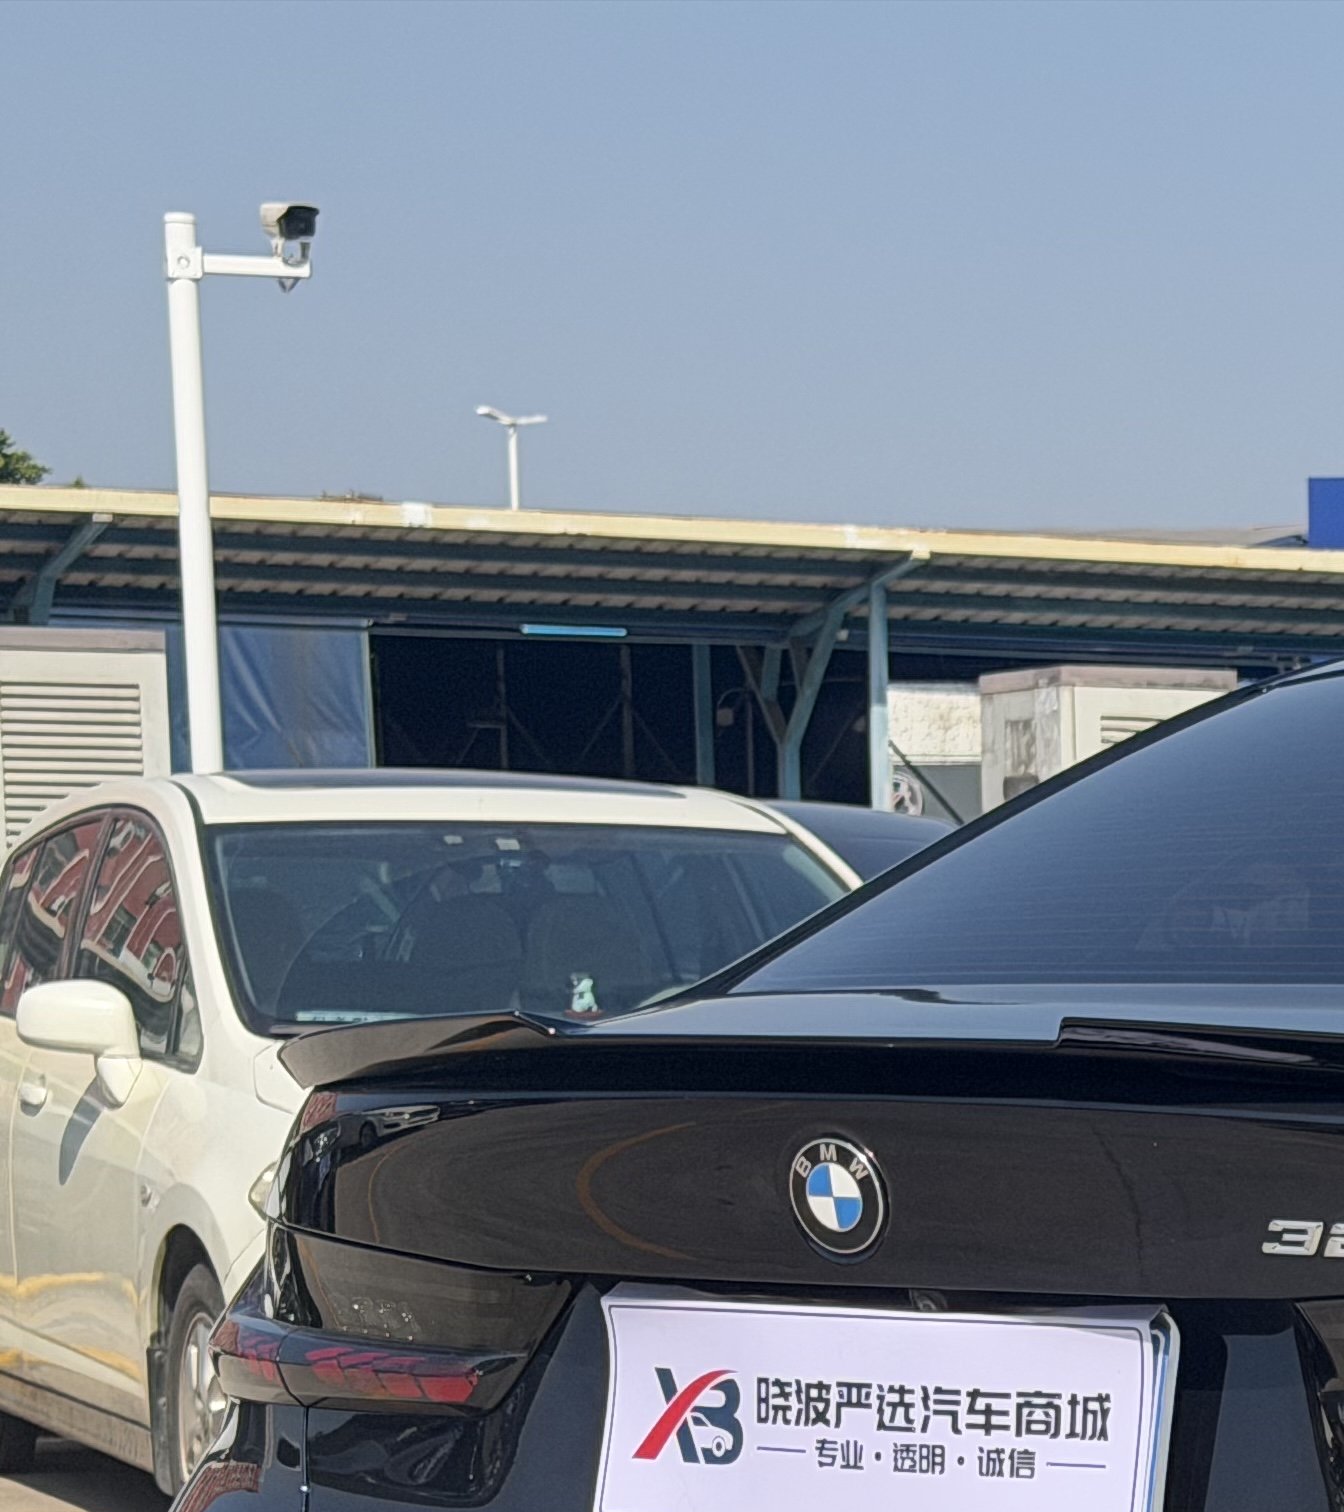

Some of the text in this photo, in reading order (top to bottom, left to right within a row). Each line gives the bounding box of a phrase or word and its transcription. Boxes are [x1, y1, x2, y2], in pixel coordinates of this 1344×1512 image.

[756, 1376, 1113, 1443] 晓波严选汽车商城
